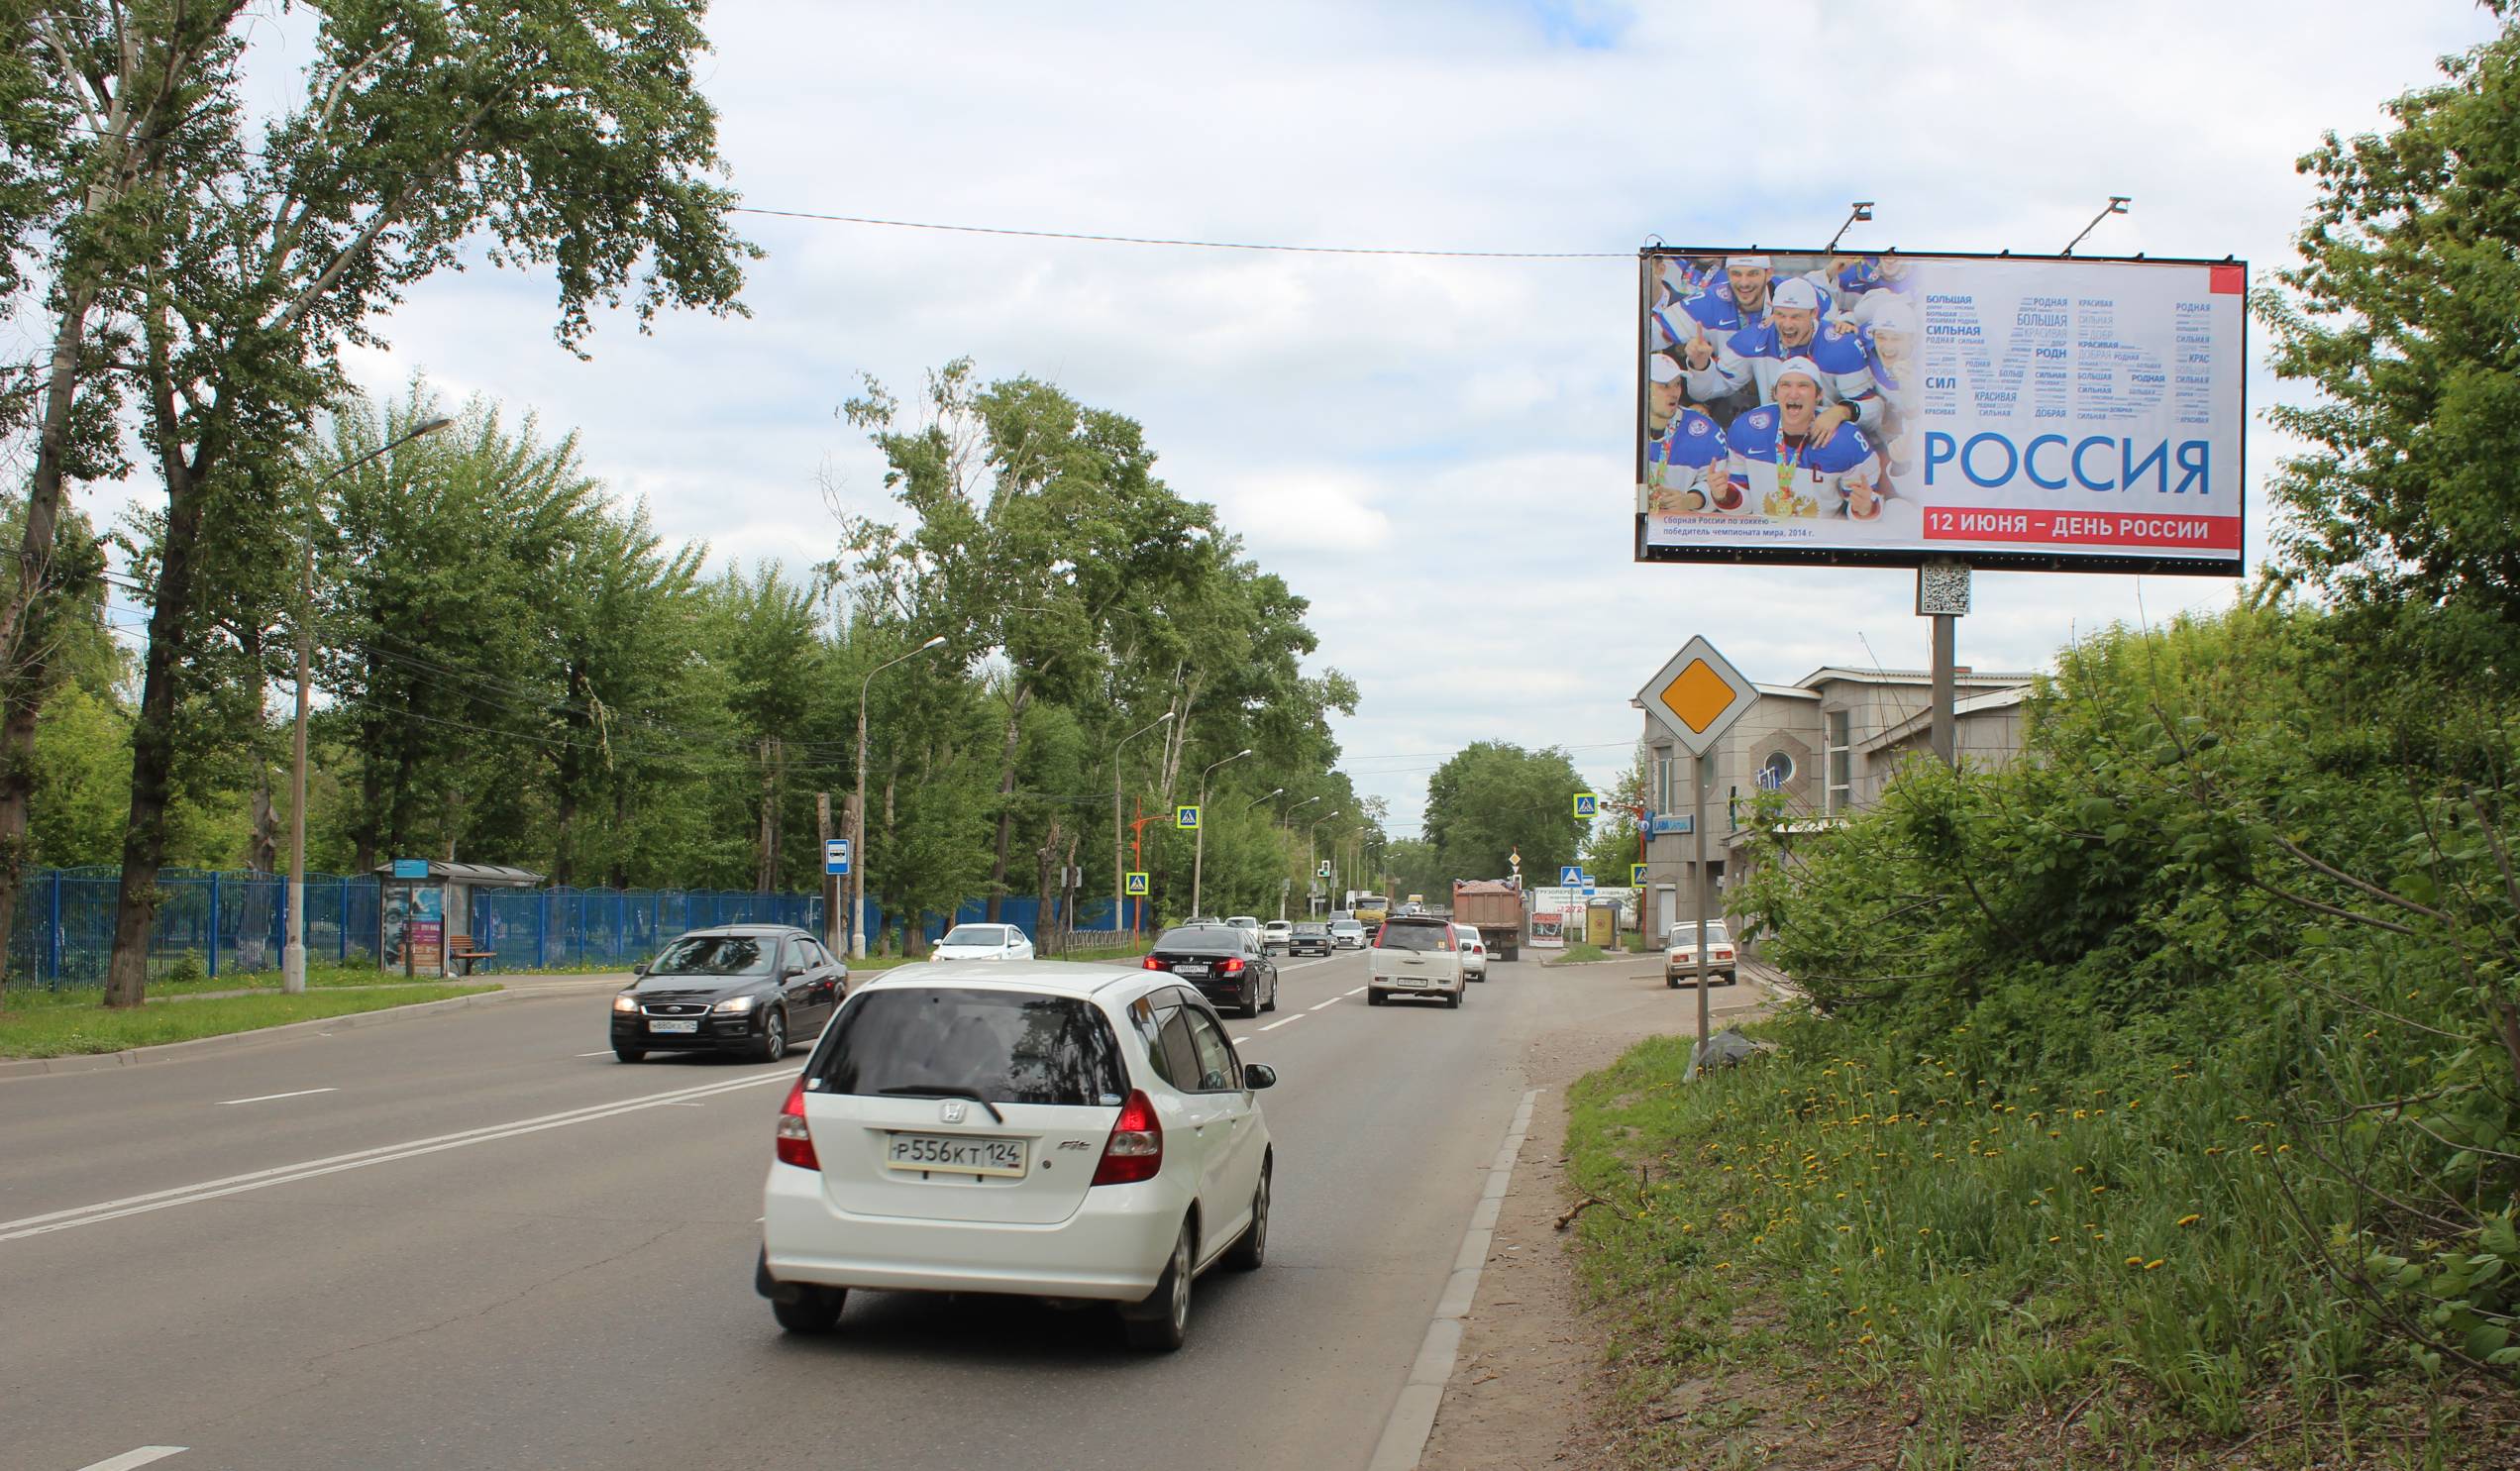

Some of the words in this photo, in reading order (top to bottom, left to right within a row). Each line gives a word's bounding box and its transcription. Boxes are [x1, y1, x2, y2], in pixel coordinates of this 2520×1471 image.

[1927, 295, 1972, 304] БОЛЬШАЯ
[2034, 298, 2067, 308] РОДНАЯ
[2176, 303, 2211, 313] РОДНАЯ
[2017, 313, 2067, 327] БОЛЬШАЯ
[1926, 325, 1981, 336] СИЛЬНАЯ
[1926, 336, 1954, 345] РОДНАЯ
[2176, 335, 2210, 344] СИЛЬНАЯ
[2036, 348, 2067, 360] РОДН
[2188, 354, 2210, 364] КРАС
[2077, 372, 2112, 381] БОЛЬШАЯ
[2131, 374, 2165, 383] РОДНАЯ
[1926, 377, 1956, 389] СИЛ
[1974, 391, 2017, 402] КРАСИВАЯ
[2035, 408, 2066, 418] ДОБРАЯ
[1925, 432, 2209, 494] РОССИЯ
[1663, 516, 1696, 526] Сборная
[1699, 516, 1726, 525] России
[1930, 513, 1953, 531] 12
[1960, 514, 2028, 533] ИЮНЯ
[2052, 516, 2113, 538] ДЕНЬ
[2120, 520, 2209, 540] РОССИИ
[897, 1139, 981, 1165] Р556КТ
[986, 1143, 1020, 1162] 124
